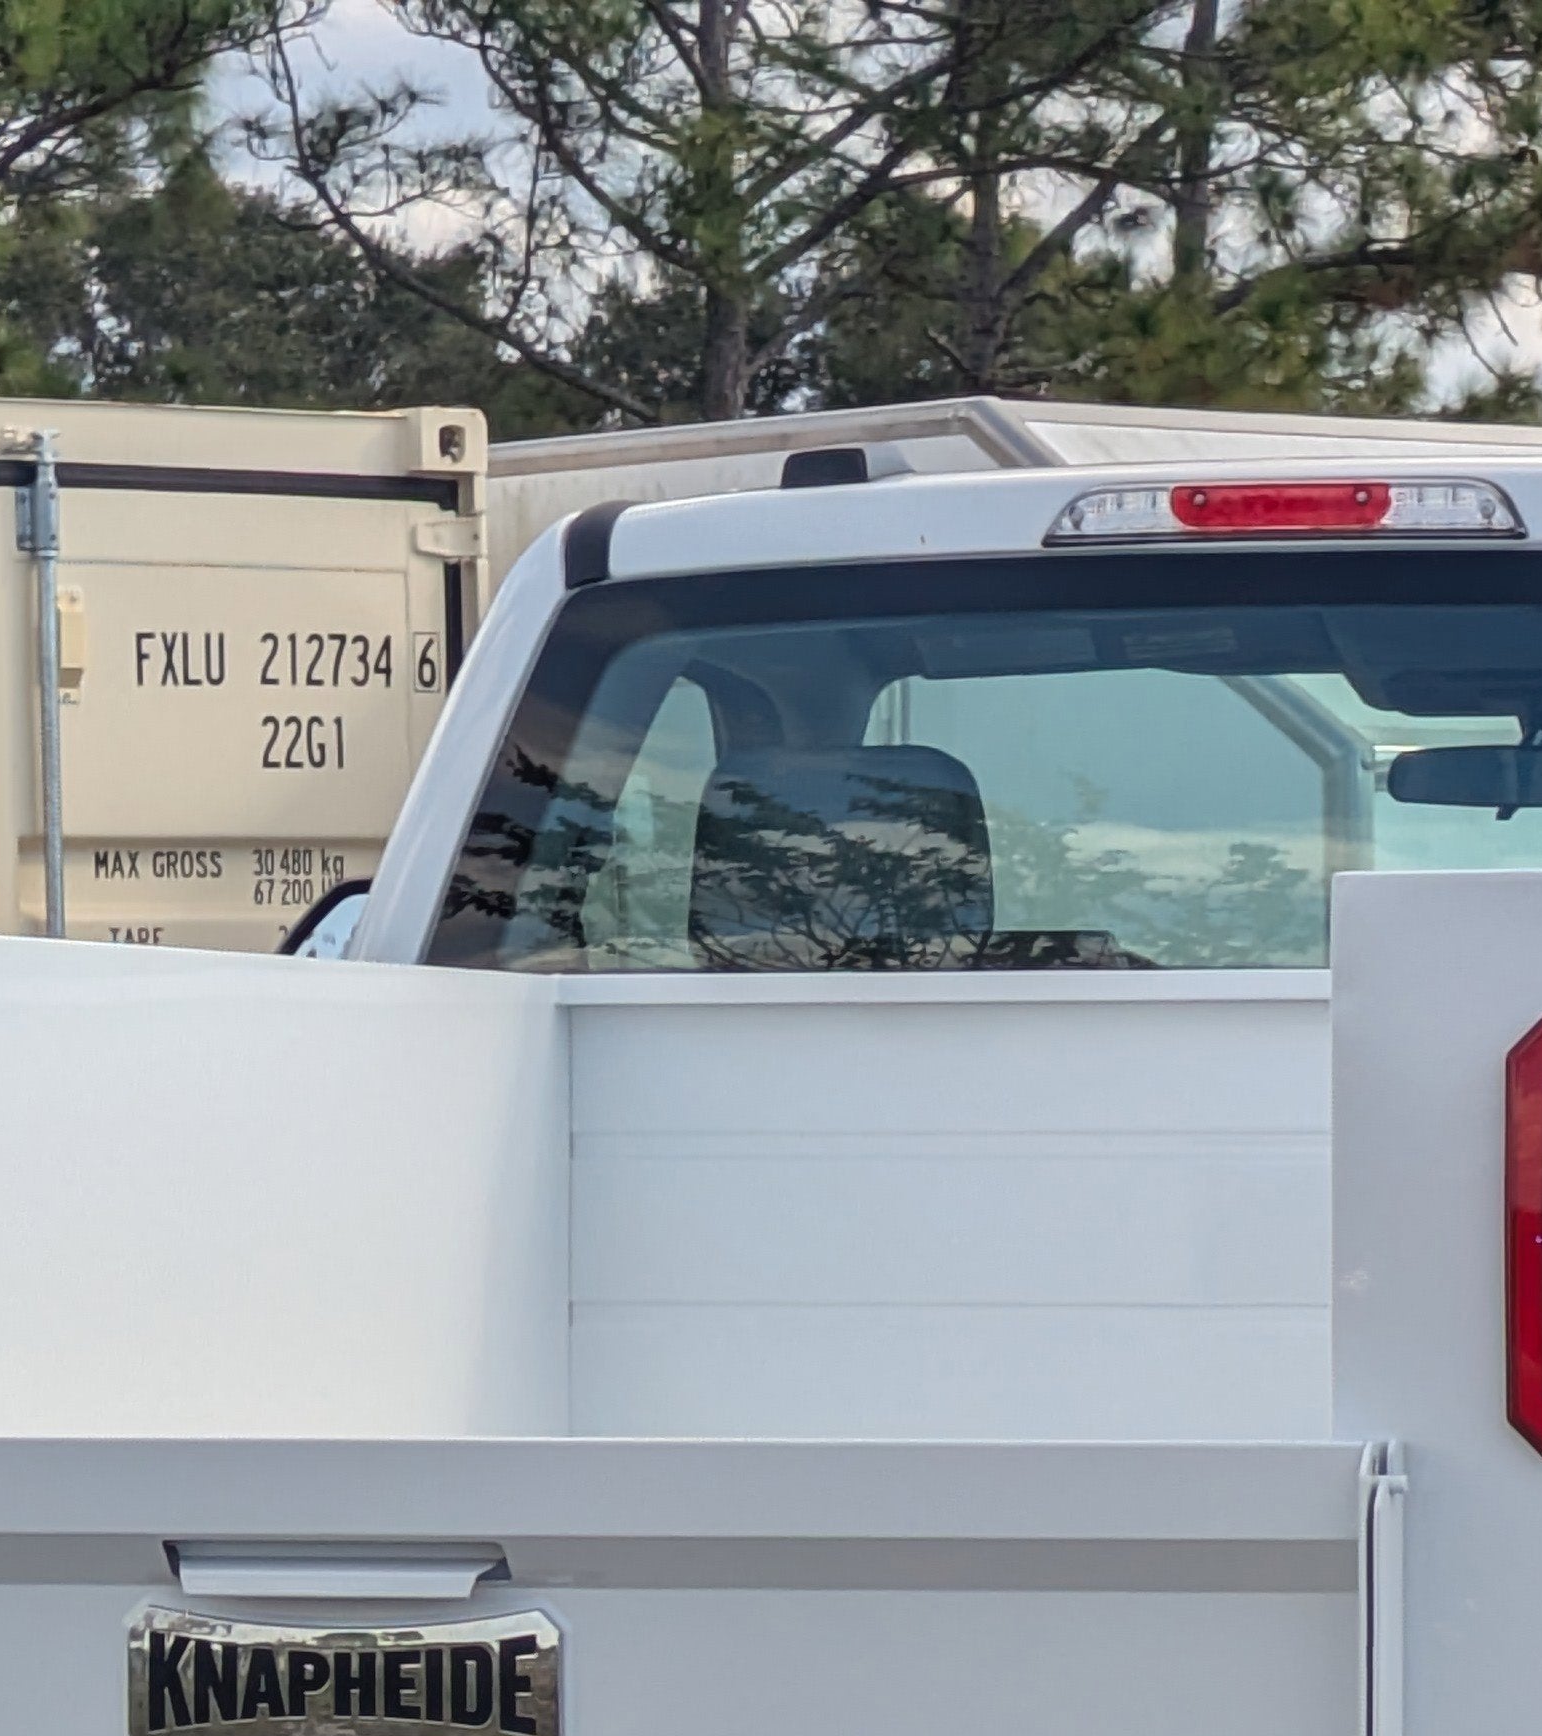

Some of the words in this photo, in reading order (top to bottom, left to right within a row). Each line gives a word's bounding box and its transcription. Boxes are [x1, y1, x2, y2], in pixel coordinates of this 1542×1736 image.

[135, 631, 226, 687] FXLU
[259, 632, 392, 688] 212734
[417, 637, 437, 689] 6
[261, 714, 345, 769] 22G1
[93, 850, 140, 879] MAX
[152, 850, 223, 879] GROSS
[320, 848, 345, 882] kg
[147, 1631, 539, 1736] KNAPHEIDE
